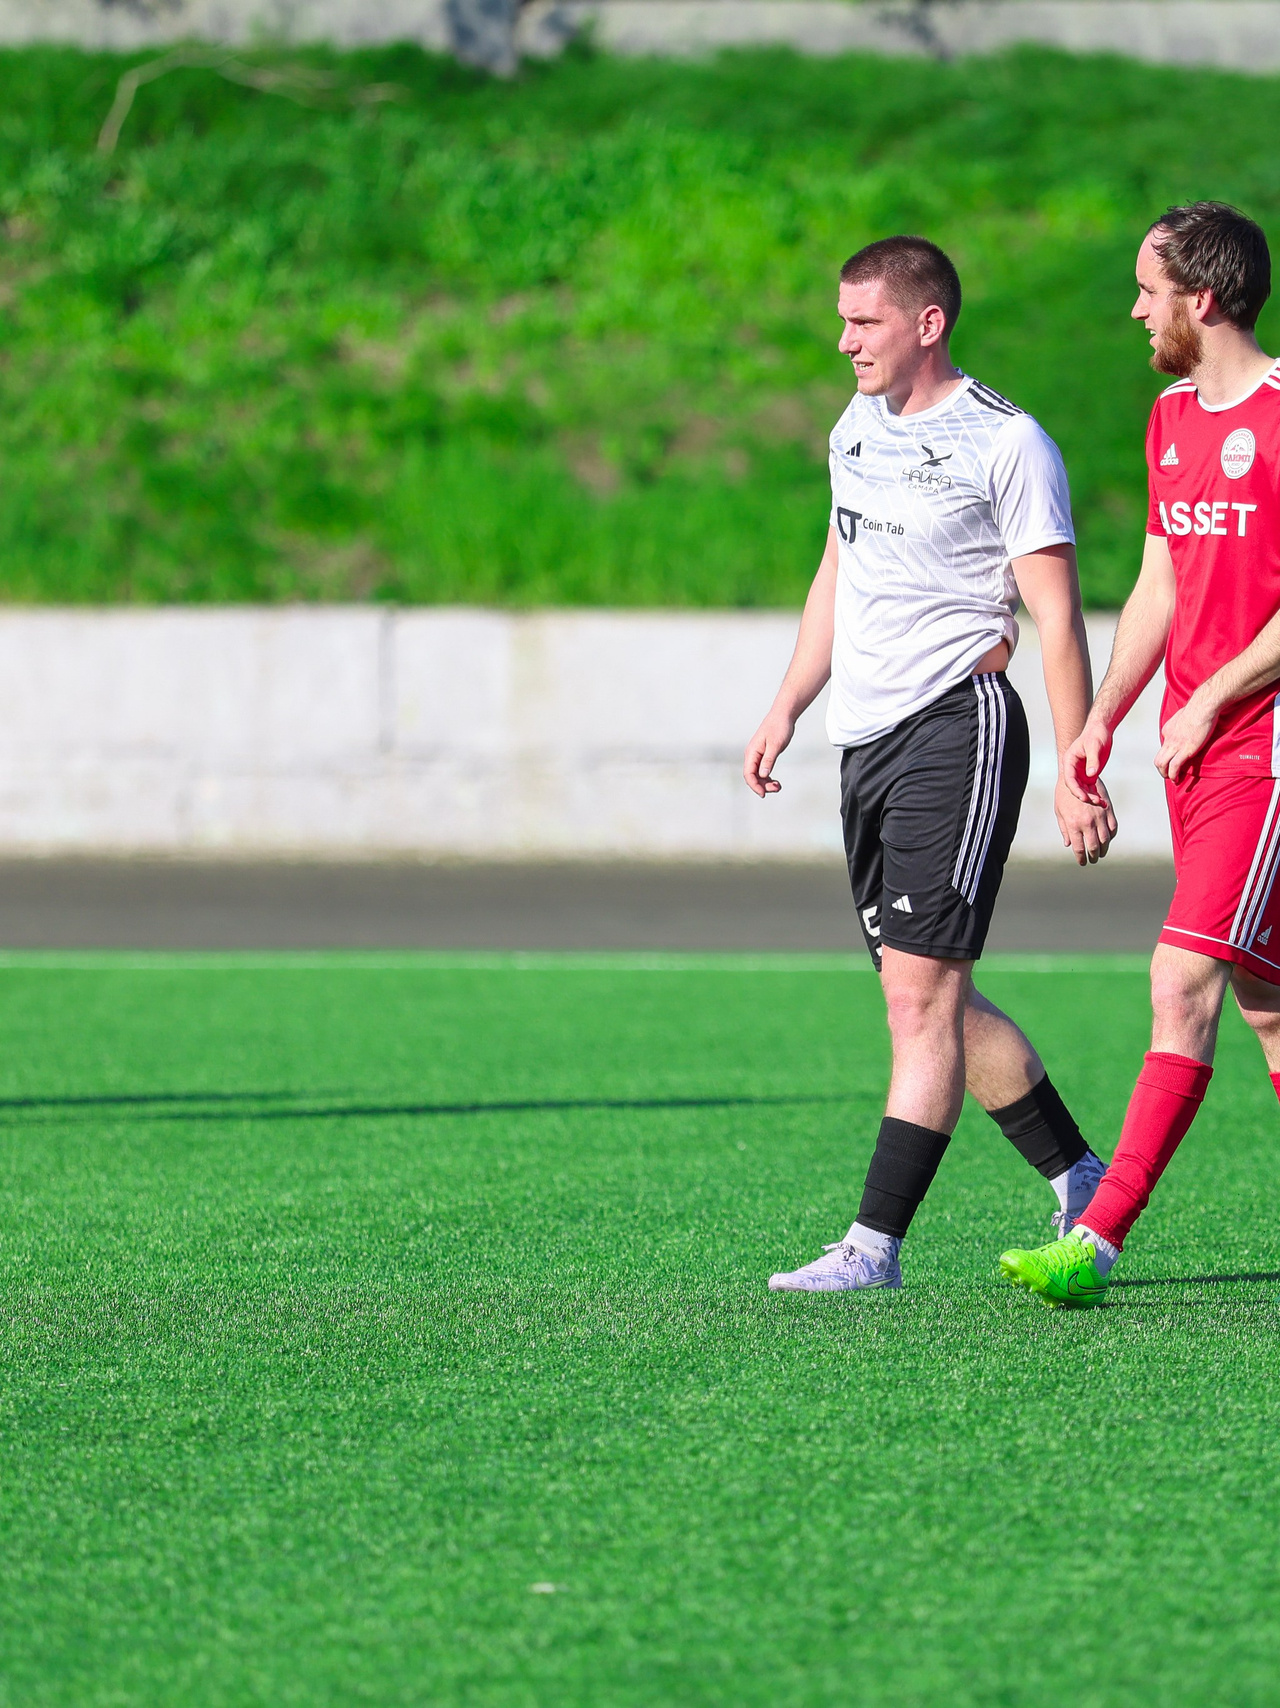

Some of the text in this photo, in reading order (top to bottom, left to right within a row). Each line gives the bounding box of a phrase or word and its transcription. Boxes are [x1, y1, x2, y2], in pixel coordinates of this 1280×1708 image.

[901, 467, 952, 489] ЧАЙКА
[862, 517, 883, 532] Coin
[885, 521, 905, 536] Tab
[1158, 501, 1258, 537] ASSET
